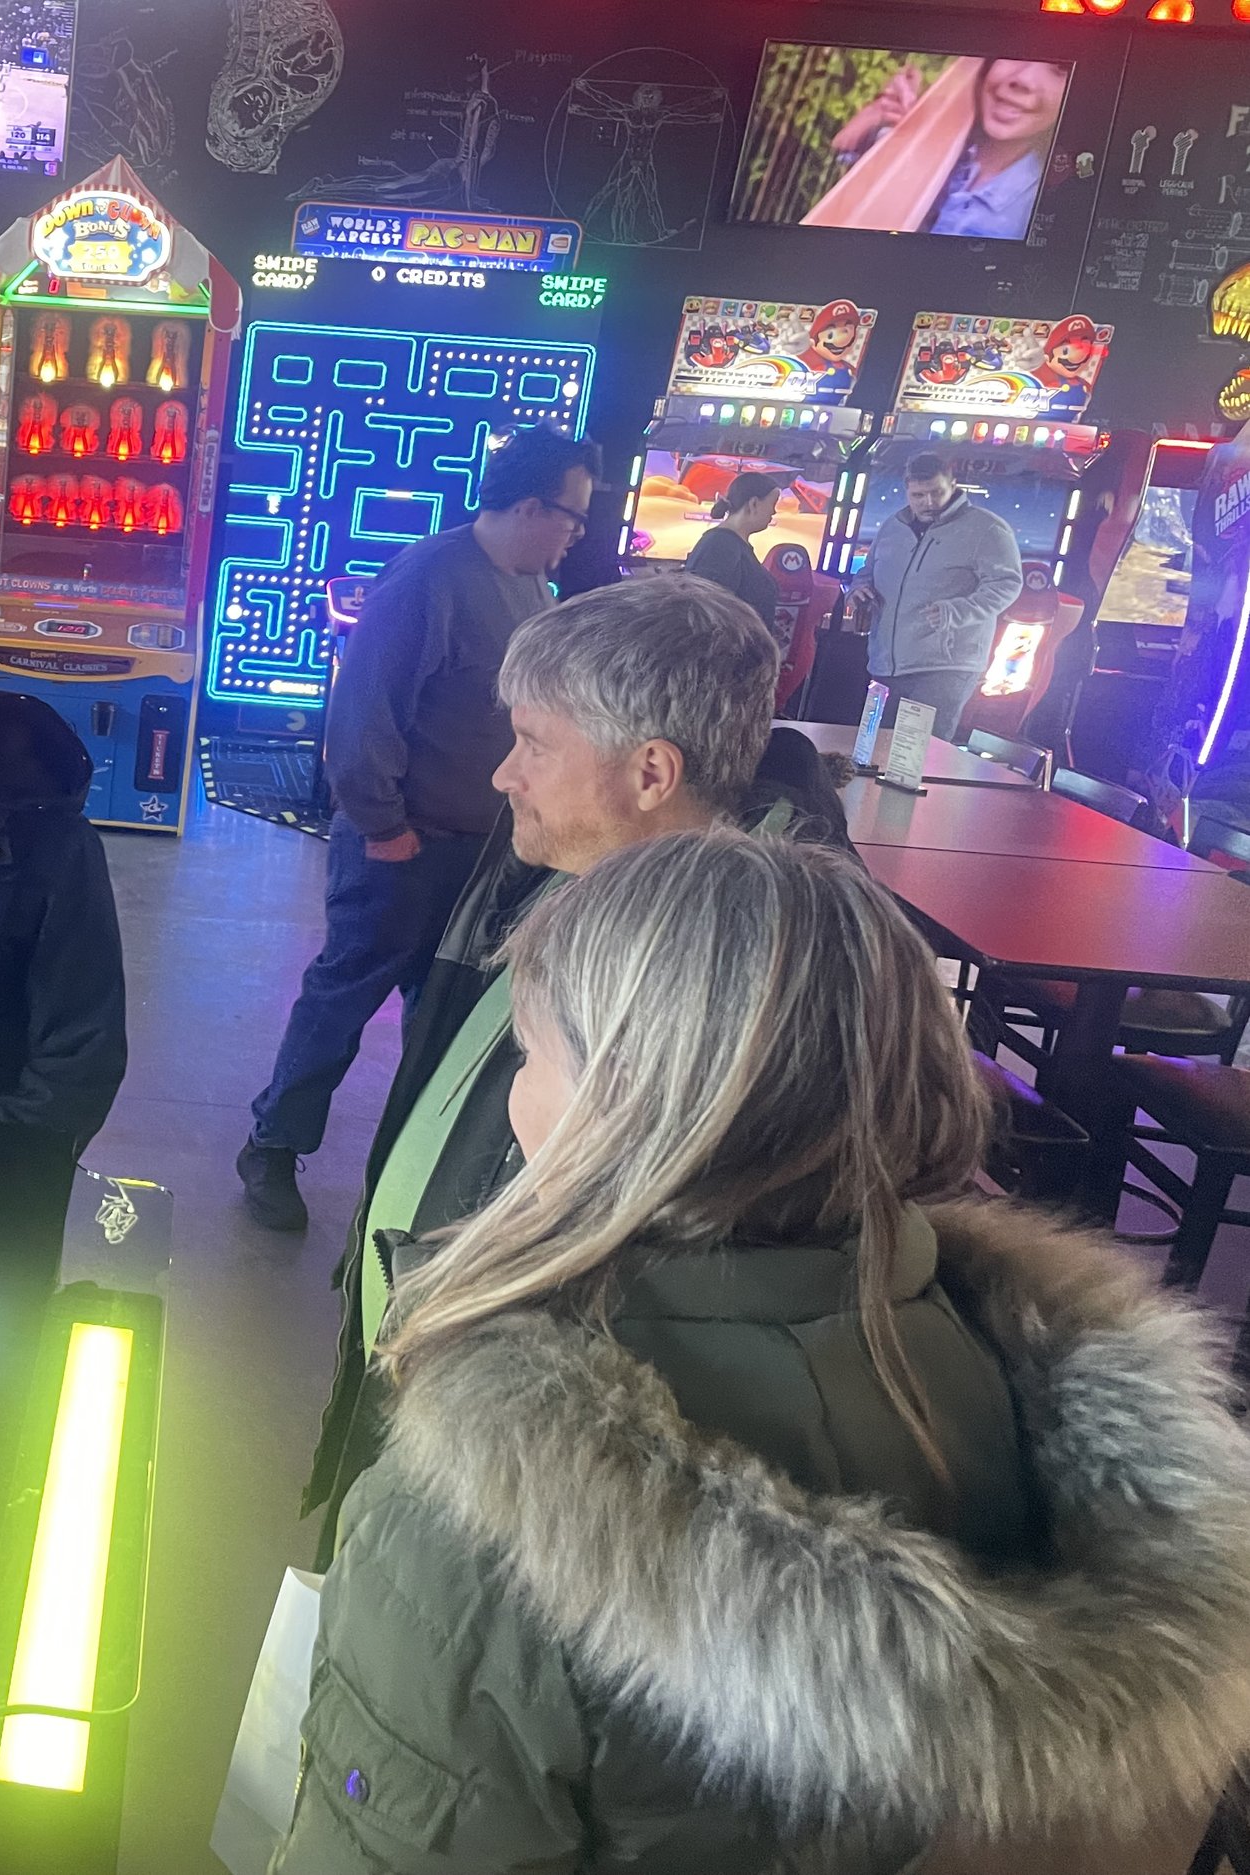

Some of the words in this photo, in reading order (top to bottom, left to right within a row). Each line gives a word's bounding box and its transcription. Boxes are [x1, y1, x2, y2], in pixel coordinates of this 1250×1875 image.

[10, 131, 26, 139] 120
[35, 133, 51, 141] 114
[73, 218, 131, 241] BONUS
[329, 216, 401, 232] WORLD'S
[325, 228, 402, 246] LARGEST
[410, 222, 538, 254] PAC-MAN
[253, 254, 318, 274] SWIPE
[251, 271, 315, 290] CARD!
[371, 266, 386, 282] 0
[396, 269, 486, 288] CREDITS
[541, 274, 608, 293] SWIPE
[539, 291, 603, 309] CARD!
[11, 579, 51, 591] CLOWNS
[53, 582, 69, 592] are
[73, 583, 97, 594] Worth
[9, 655, 59, 671] CARNIVAL
[63, 661, 108, 673] CLASSICS
